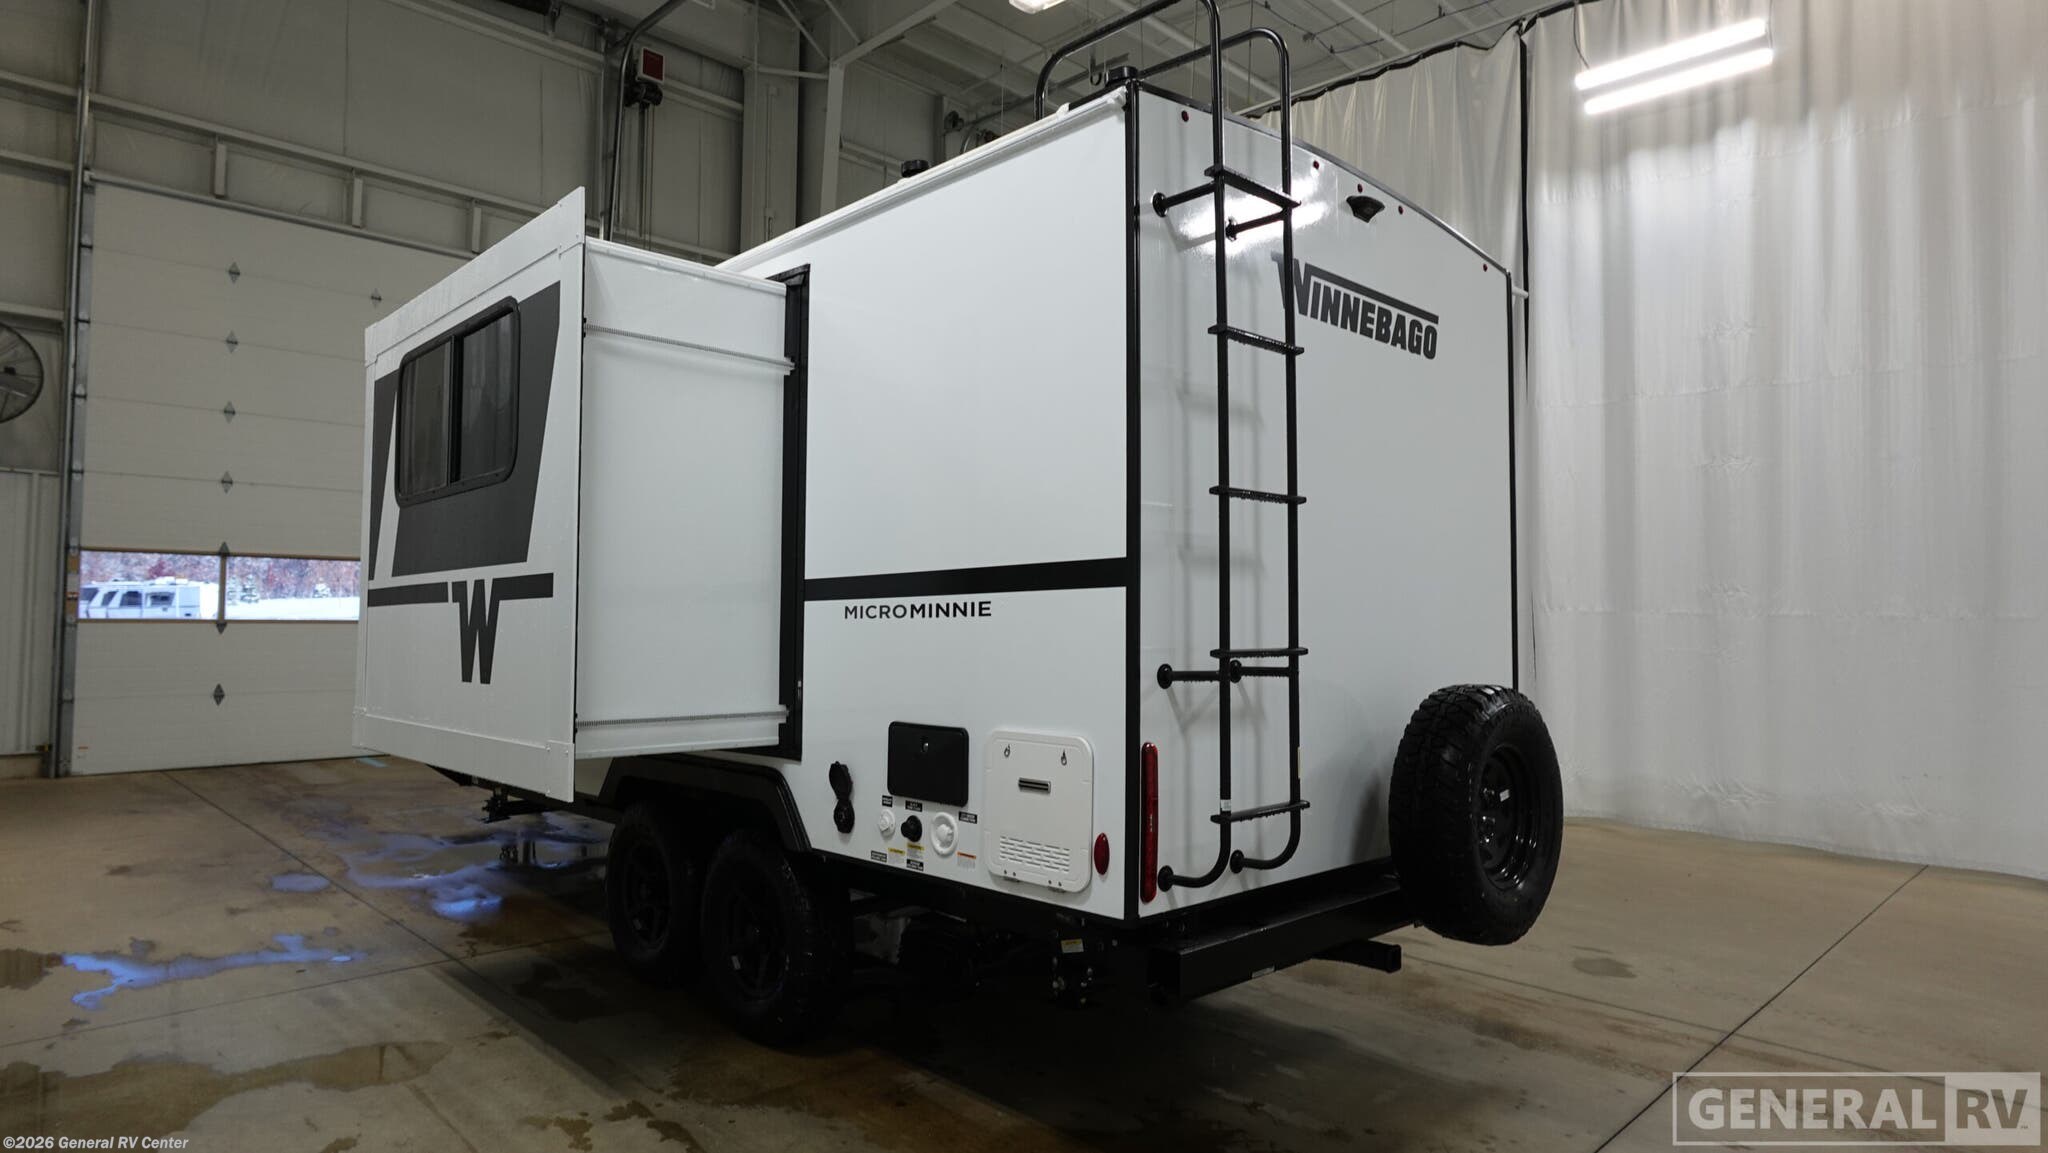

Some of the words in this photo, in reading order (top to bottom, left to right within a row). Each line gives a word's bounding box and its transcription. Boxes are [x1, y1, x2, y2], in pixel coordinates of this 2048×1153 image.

[1271, 251, 1439, 360] WINNEBAGO
[452, 579, 501, 684] W
[844, 601, 992, 619] MICROMINNIE
